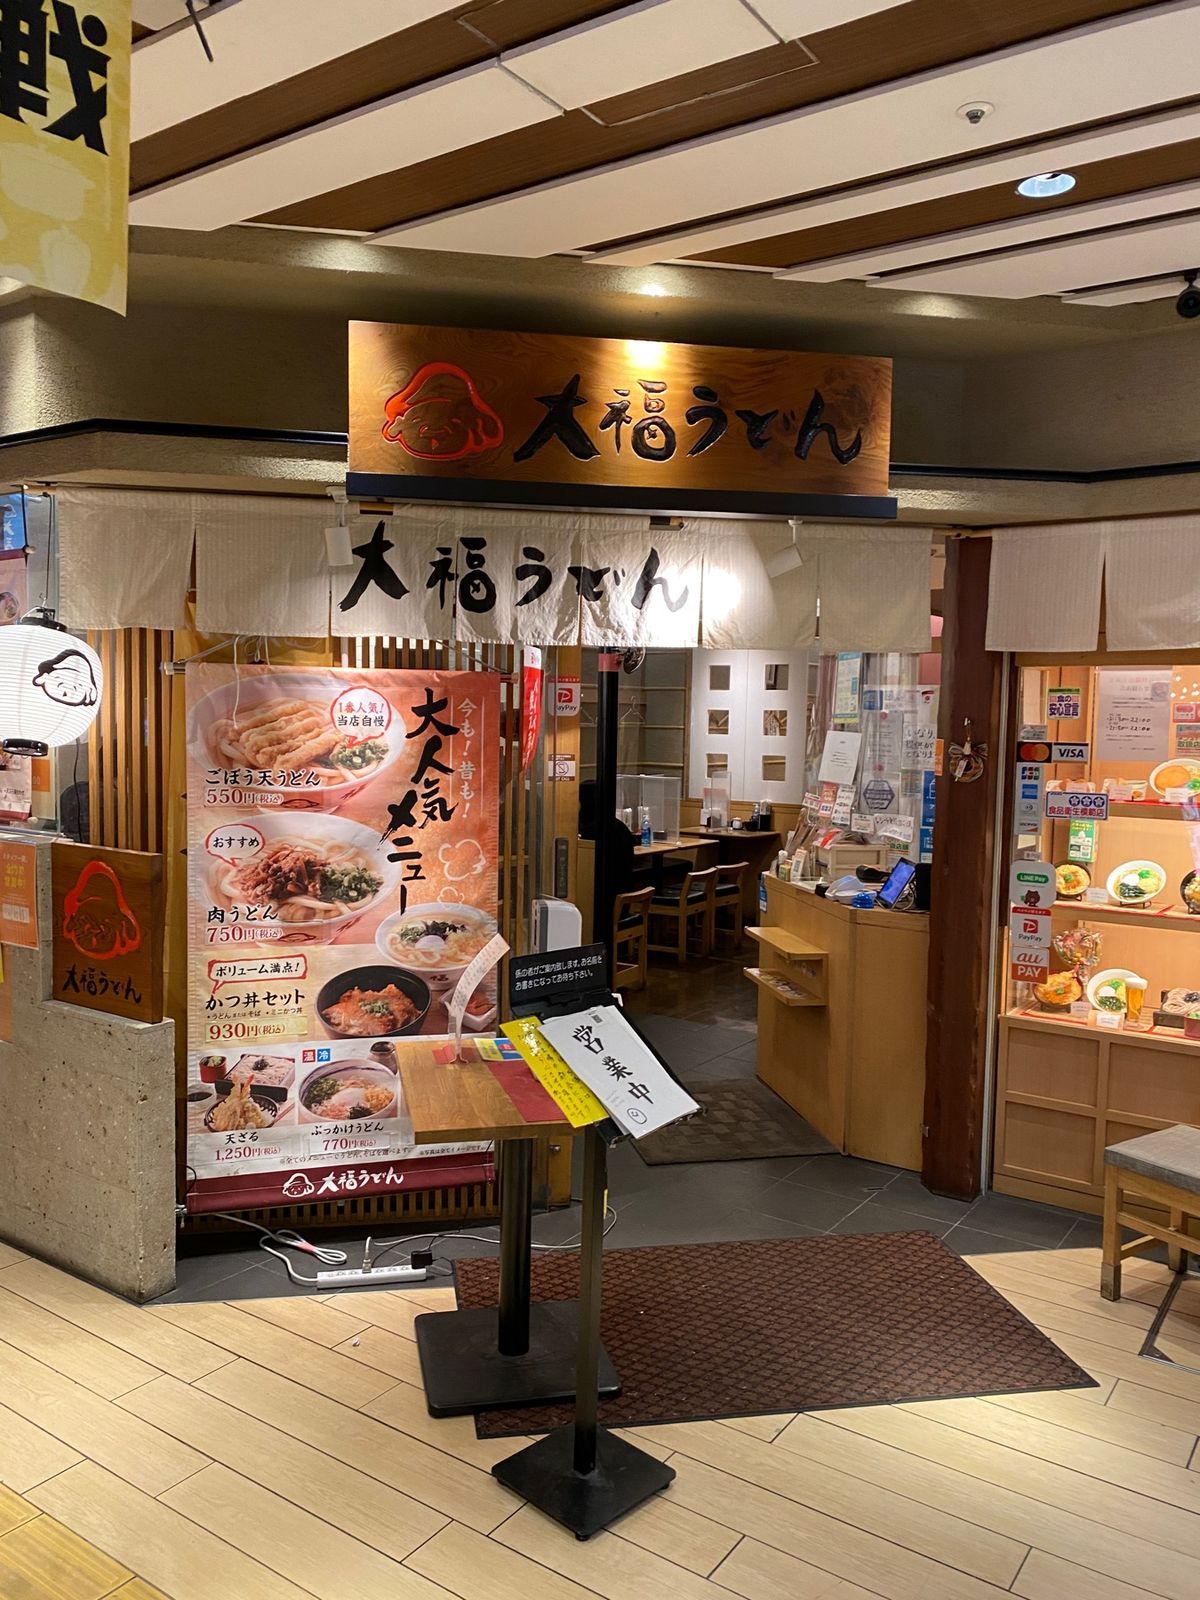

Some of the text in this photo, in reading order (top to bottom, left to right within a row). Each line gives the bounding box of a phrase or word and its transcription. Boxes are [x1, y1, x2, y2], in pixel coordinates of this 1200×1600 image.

[513, 373, 863, 466] 大福うどん
[339, 519, 690, 613] 大福うどん
[1056, 694, 1072, 703] 食の
[337, 702, 385, 715] 1番人気!
[1048, 702, 1080, 717] 安心宣言
[336, 714, 386, 728] 当店自慢
[1058, 748, 1085, 758] VISA
[205, 768, 321, 787] ごぼう天うどん
[1021, 767, 1040, 780] JCB
[206, 788, 284, 805] 550円(税込)
[1048, 805, 1105, 817] 食品衛生模範店
[212, 835, 260, 849] おすすめ
[207, 905, 279, 924] 肉うどん
[206, 926, 283, 943] 750円(税込)
[1018, 933, 1043, 942] PayPay
[1016, 952, 1043, 964] au
[215, 961, 300, 977] ボリューム満点!
[1017, 967, 1041, 978] PAY
[62, 963, 142, 1004] 大福うどん
[205, 988, 306, 1011] かつ丼セット
[209, 1022, 286, 1040] 930円(税込)
[303, 1050, 329, 1062] 温 冷
[571, 1024, 655, 1105] 営業中
[311, 1122, 384, 1136] ぶっかけうどん
[224, 1131, 259, 1145] 天ざる
[322, 1137, 377, 1151] 770円(税込)
[215, 1145, 281, 1161] 1,250円(税込)
[316, 1166, 405, 1195] 大福うどん
